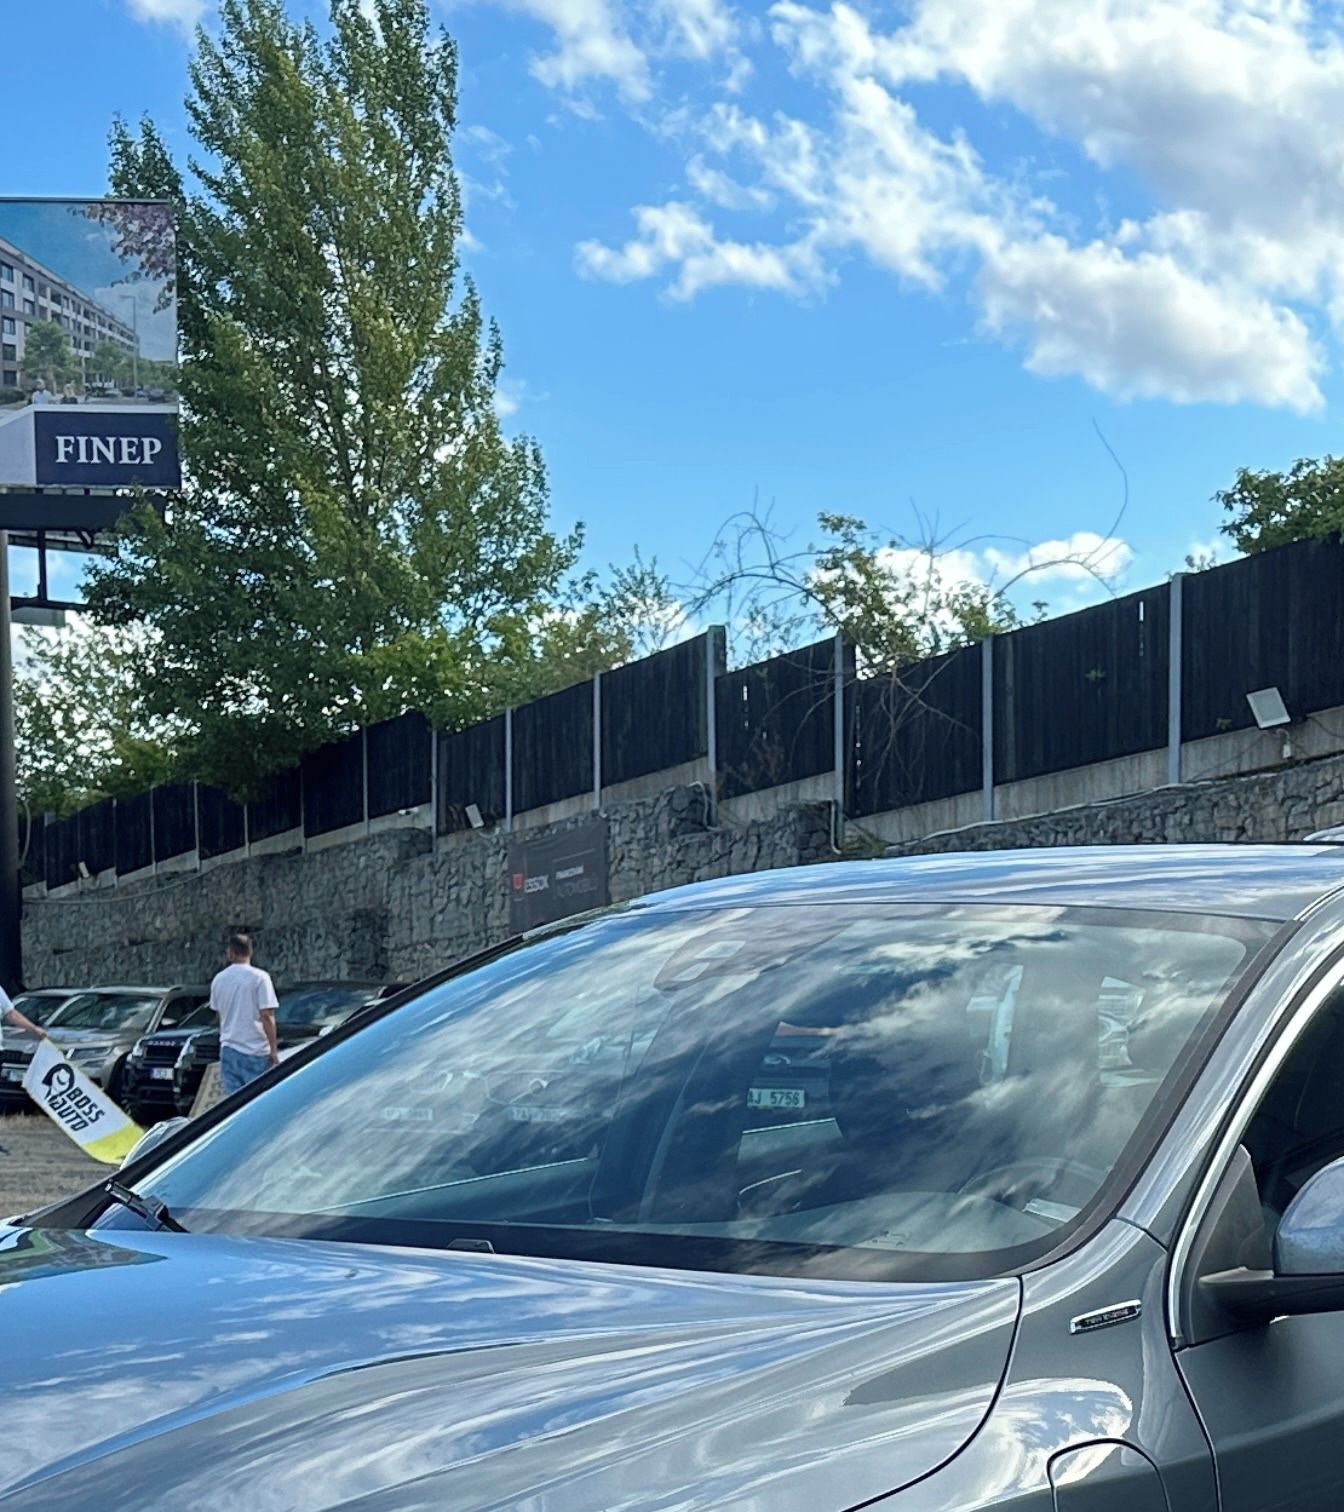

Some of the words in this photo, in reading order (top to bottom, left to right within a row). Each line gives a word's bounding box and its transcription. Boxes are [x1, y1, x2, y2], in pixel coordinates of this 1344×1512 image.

[55, 435, 162, 465] FINEP
[47, 1096, 89, 1132] AUTO
[66, 1087, 105, 1124] BOSS
